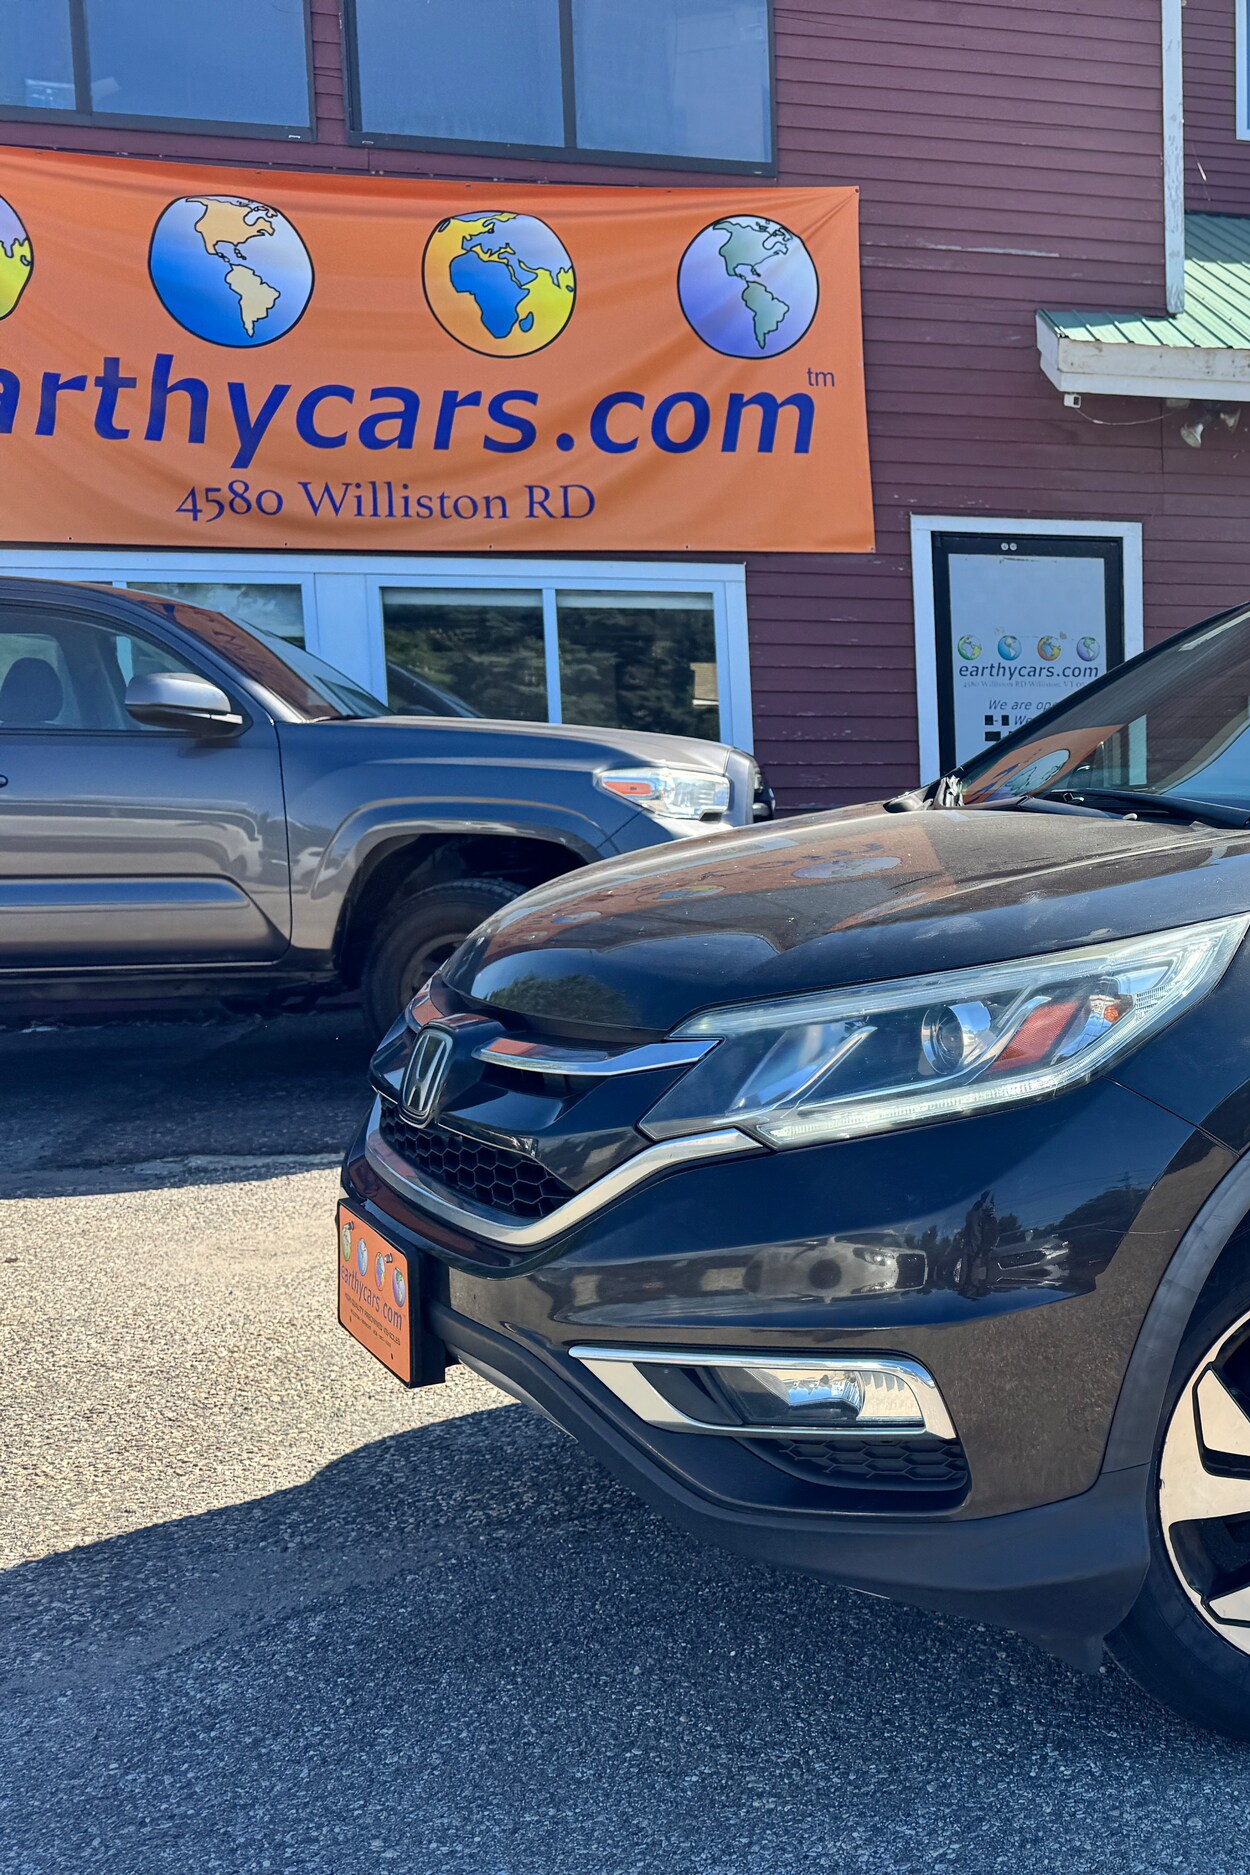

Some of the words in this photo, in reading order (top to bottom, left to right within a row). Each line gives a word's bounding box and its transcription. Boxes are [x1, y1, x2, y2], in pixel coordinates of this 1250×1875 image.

[175, 479, 284, 523] 4580
[297, 480, 510, 520] Williston
[523, 483, 596, 520] RD
[958, 662, 1099, 681] earthycars.com
[988, 699, 1008, 711] We
[1011, 701, 1033, 711] are
